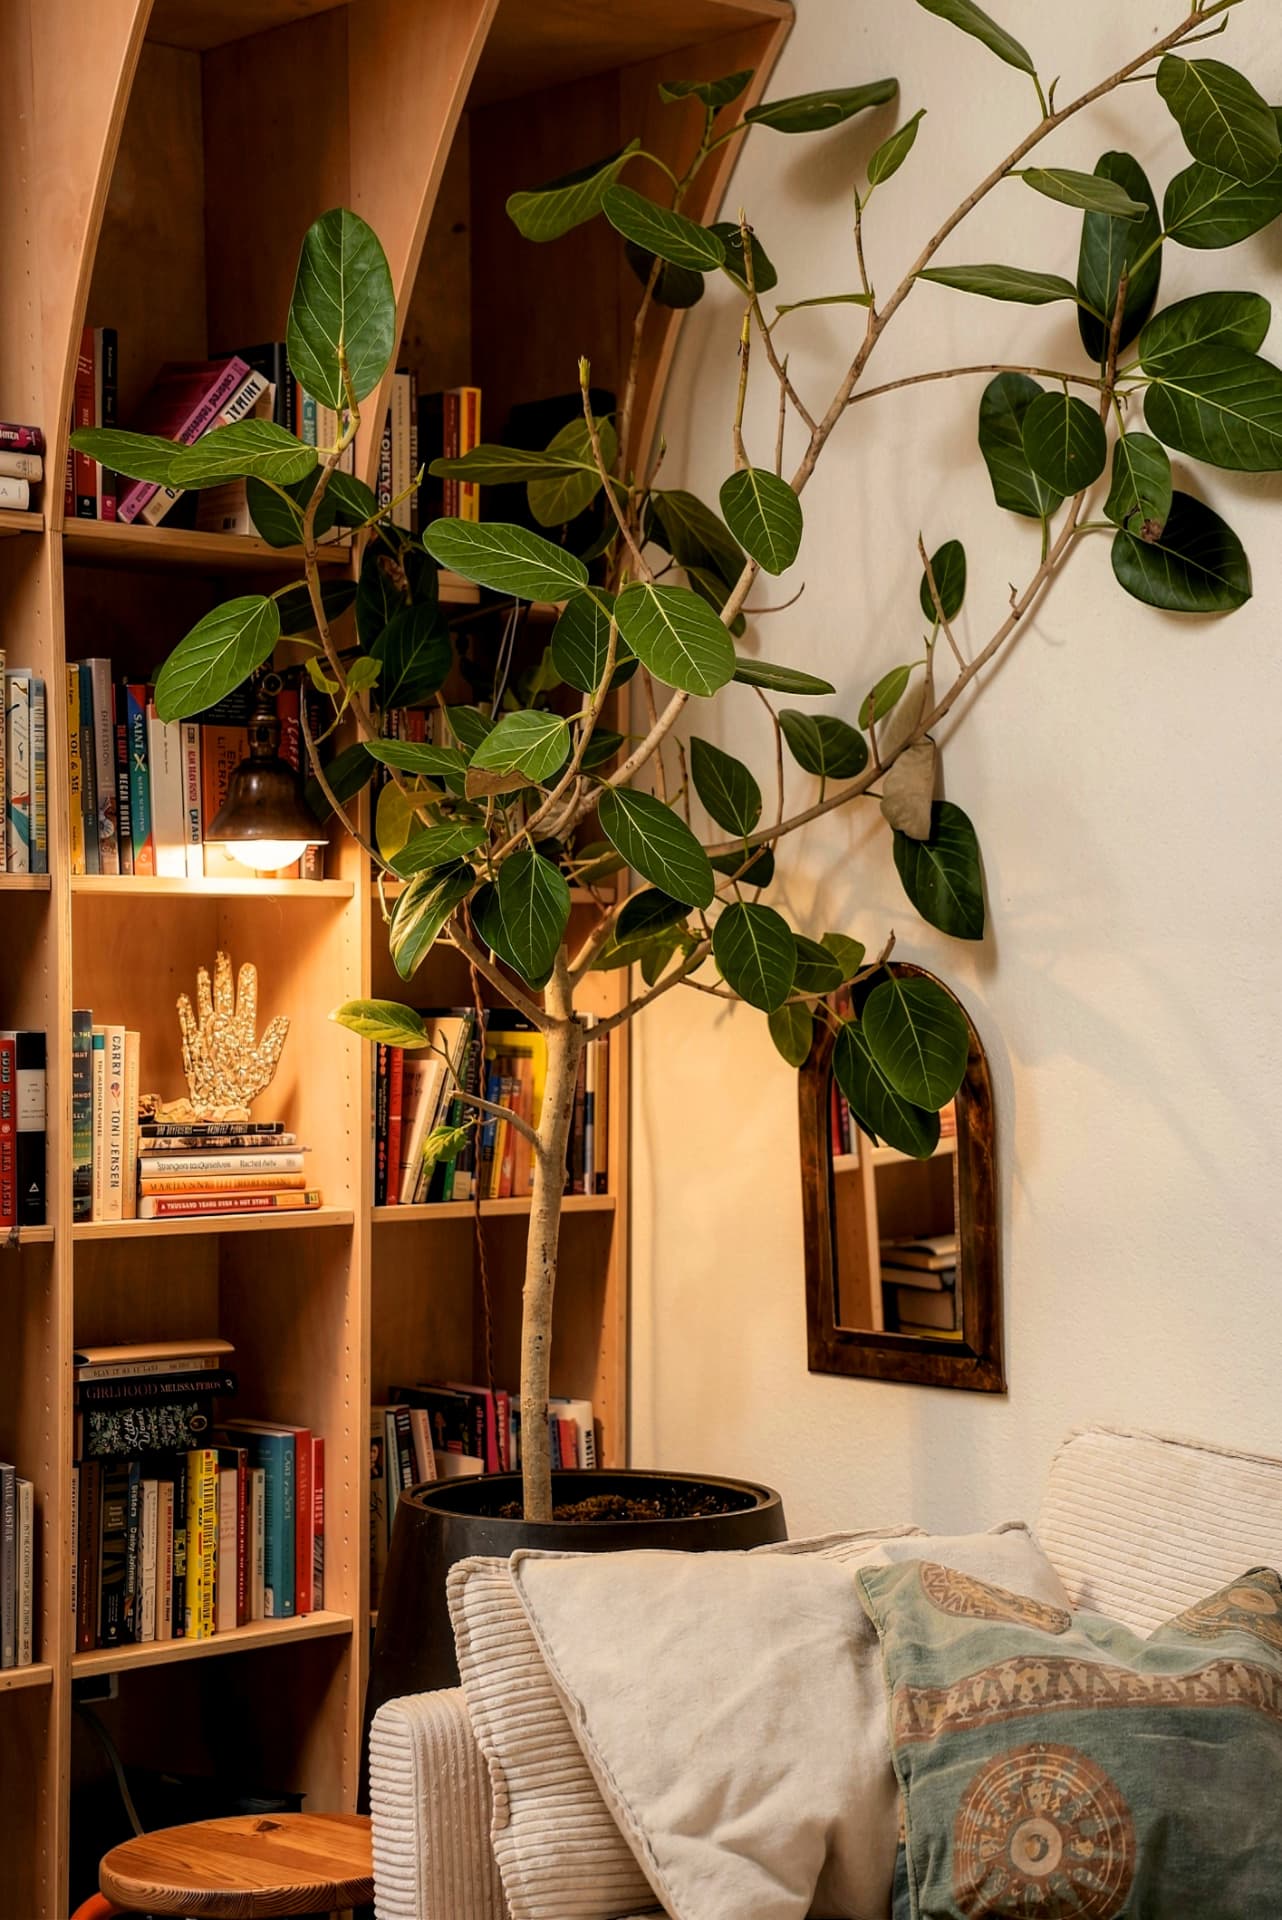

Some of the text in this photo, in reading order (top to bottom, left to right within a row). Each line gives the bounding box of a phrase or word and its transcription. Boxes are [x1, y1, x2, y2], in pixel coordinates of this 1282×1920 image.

[132, 713, 143, 749] SAINT
[3, 1050, 12, 1083] GOOD
[3, 1089, 12, 1119] TALK
[110, 1035, 122, 1188] CARRY TONI JENSEN
[240, 1159, 262, 1169] Rachel
[2, 1178, 12, 1217] JACOB
[86, 1383, 158, 1399] GIRLHOOD
[160, 1382, 195, 1393] MELISSA
[5, 1473, 14, 1498] PAUL
[129, 1484, 138, 1518] Sisters
